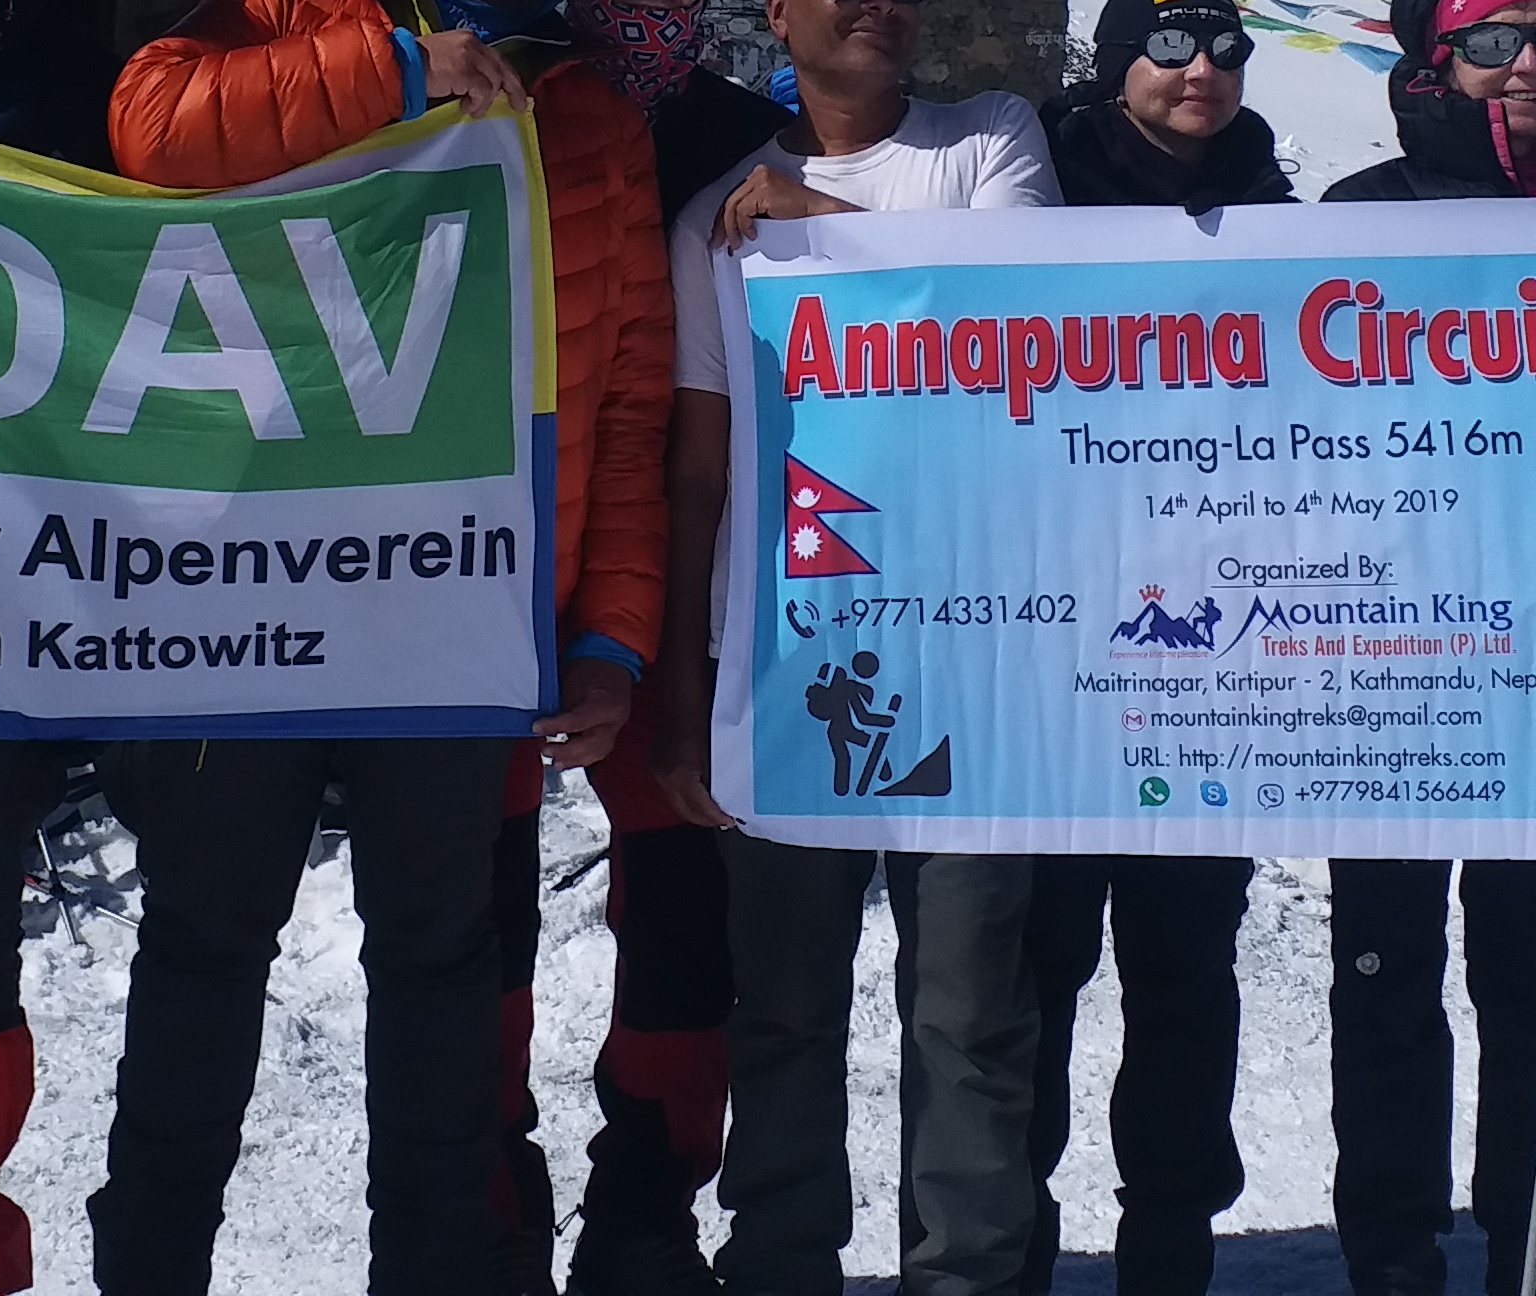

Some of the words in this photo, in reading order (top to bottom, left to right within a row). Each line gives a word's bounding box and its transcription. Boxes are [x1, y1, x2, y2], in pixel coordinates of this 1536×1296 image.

[783, 294, 1268, 424] Annapurna
[1061, 423, 1275, 473] Thorang-La
[1290, 424, 1371, 460] Pass
[1386, 419, 1523, 458] 5416m
[1146, 493, 1188, 519] 14th
[1196, 491, 1256, 524] April
[1264, 496, 1286, 516] to
[1293, 490, 1322, 516] 4th
[1330, 491, 1385, 522] May
[1395, 488, 1459, 514] 2019
[19, 514, 517, 600] Alpenverein
[1217, 551, 1349, 586] Organized
[1359, 555, 1394, 585] By:
[831, 593, 1077, 629] +97714331402
[1214, 594, 1419, 660] Mountain
[1431, 593, 1514, 631] King
[27, 620, 326, 670] Kattowitz
[1261, 635, 1308, 657] Treks
[1315, 634, 1346, 656] And
[1353, 633, 1443, 660] Expedition
[1450, 633, 1476, 656] (P)
[1483, 632, 1517, 655] Ltd.
[1074, 671, 1208, 698] Maitrinagar,
[1216, 670, 1297, 698] Kirtipur
[1320, 669, 1342, 695] 2,
[1350, 666, 1483, 694] Kathmandu,
[1151, 702, 1482, 733] mountainkingtreks@gmail.com
[1123, 747, 1171, 768] URL:
[1179, 742, 1506, 774] http://mountainkingtreks.com
[1295, 779, 1506, 803] +9779841566449
